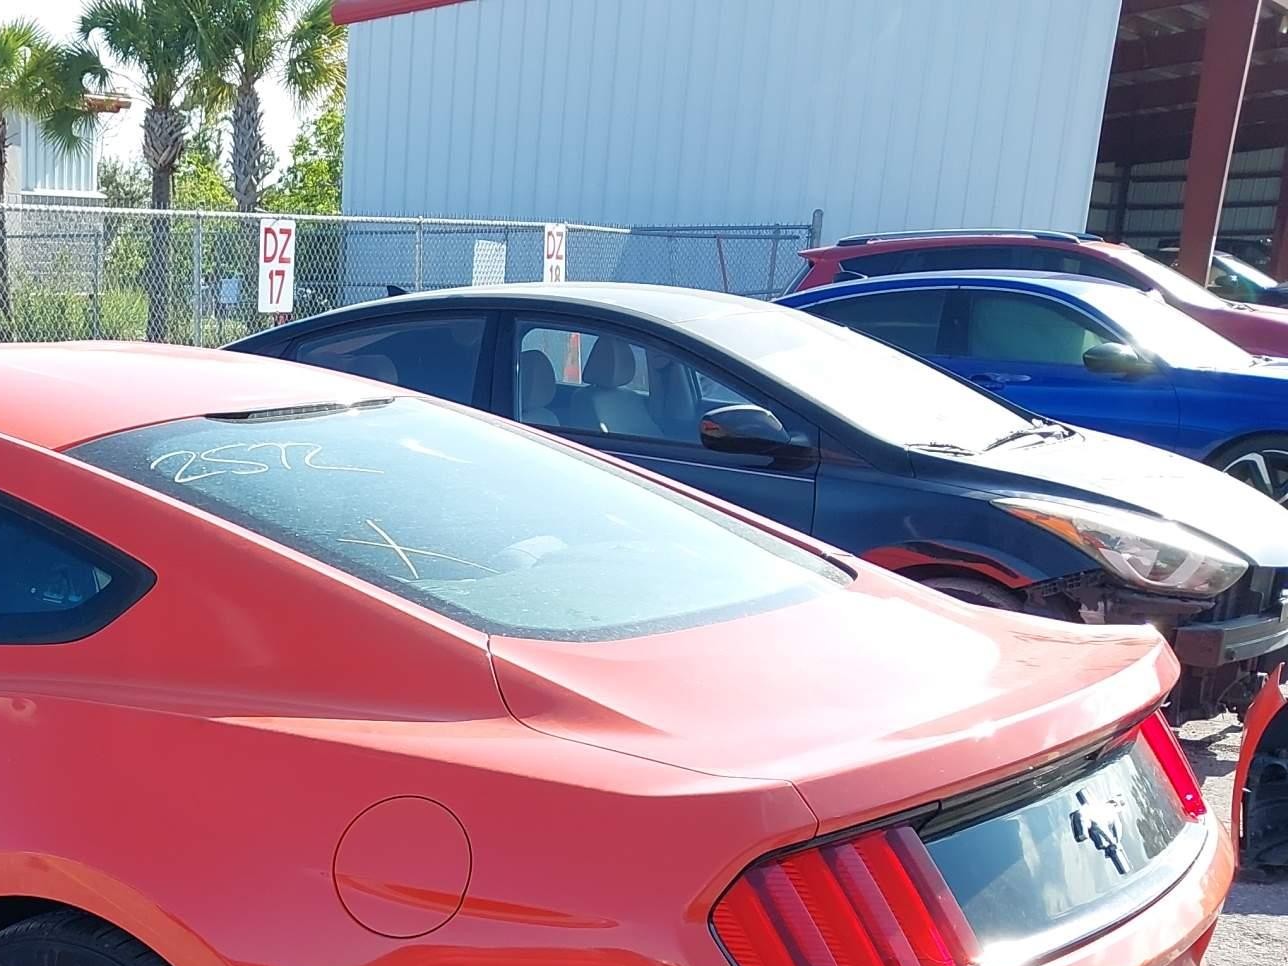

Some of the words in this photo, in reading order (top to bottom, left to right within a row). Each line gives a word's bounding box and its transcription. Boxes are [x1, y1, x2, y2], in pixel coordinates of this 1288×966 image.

[263, 227, 292, 264] DZ
[547, 231, 564, 260] DZ
[269, 270, 285, 304] 17
